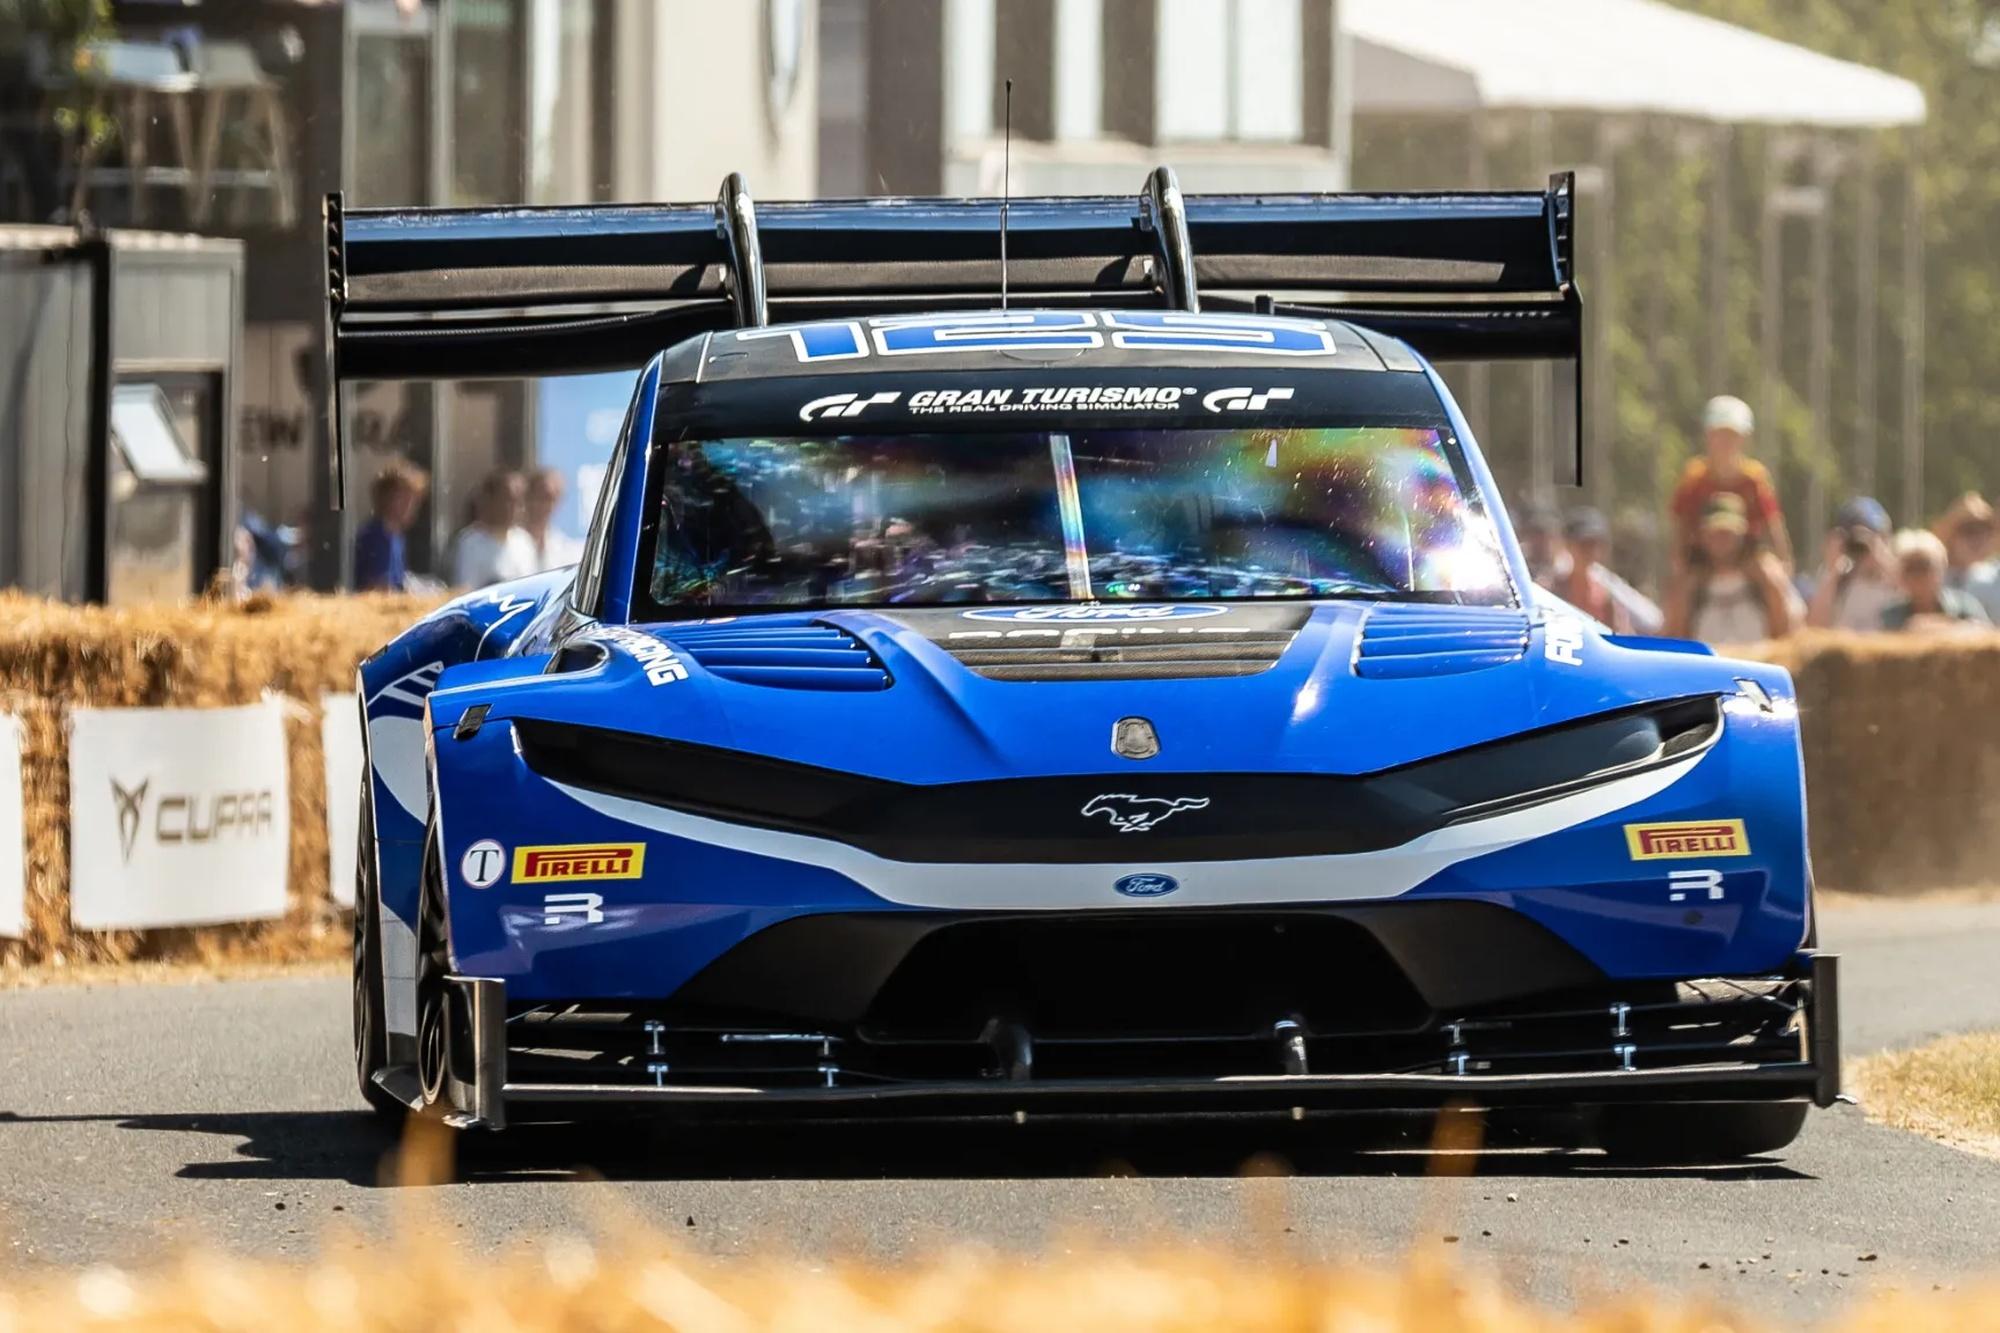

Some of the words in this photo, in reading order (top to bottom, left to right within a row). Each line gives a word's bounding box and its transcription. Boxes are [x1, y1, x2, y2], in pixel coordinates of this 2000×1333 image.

[908, 388, 1014, 407] GRAN
[909, 406, 945, 415] THE
[949, 404, 996, 413] REAL
[999, 402, 1073, 412] DRIVING
[1076, 401, 1180, 411] SIMULATOR
[1638, 826, 1738, 855] PIRELLI
[469, 850, 500, 882] T
[524, 848, 634, 878] PIRELLI
[1125, 877, 1166, 893] Ford
